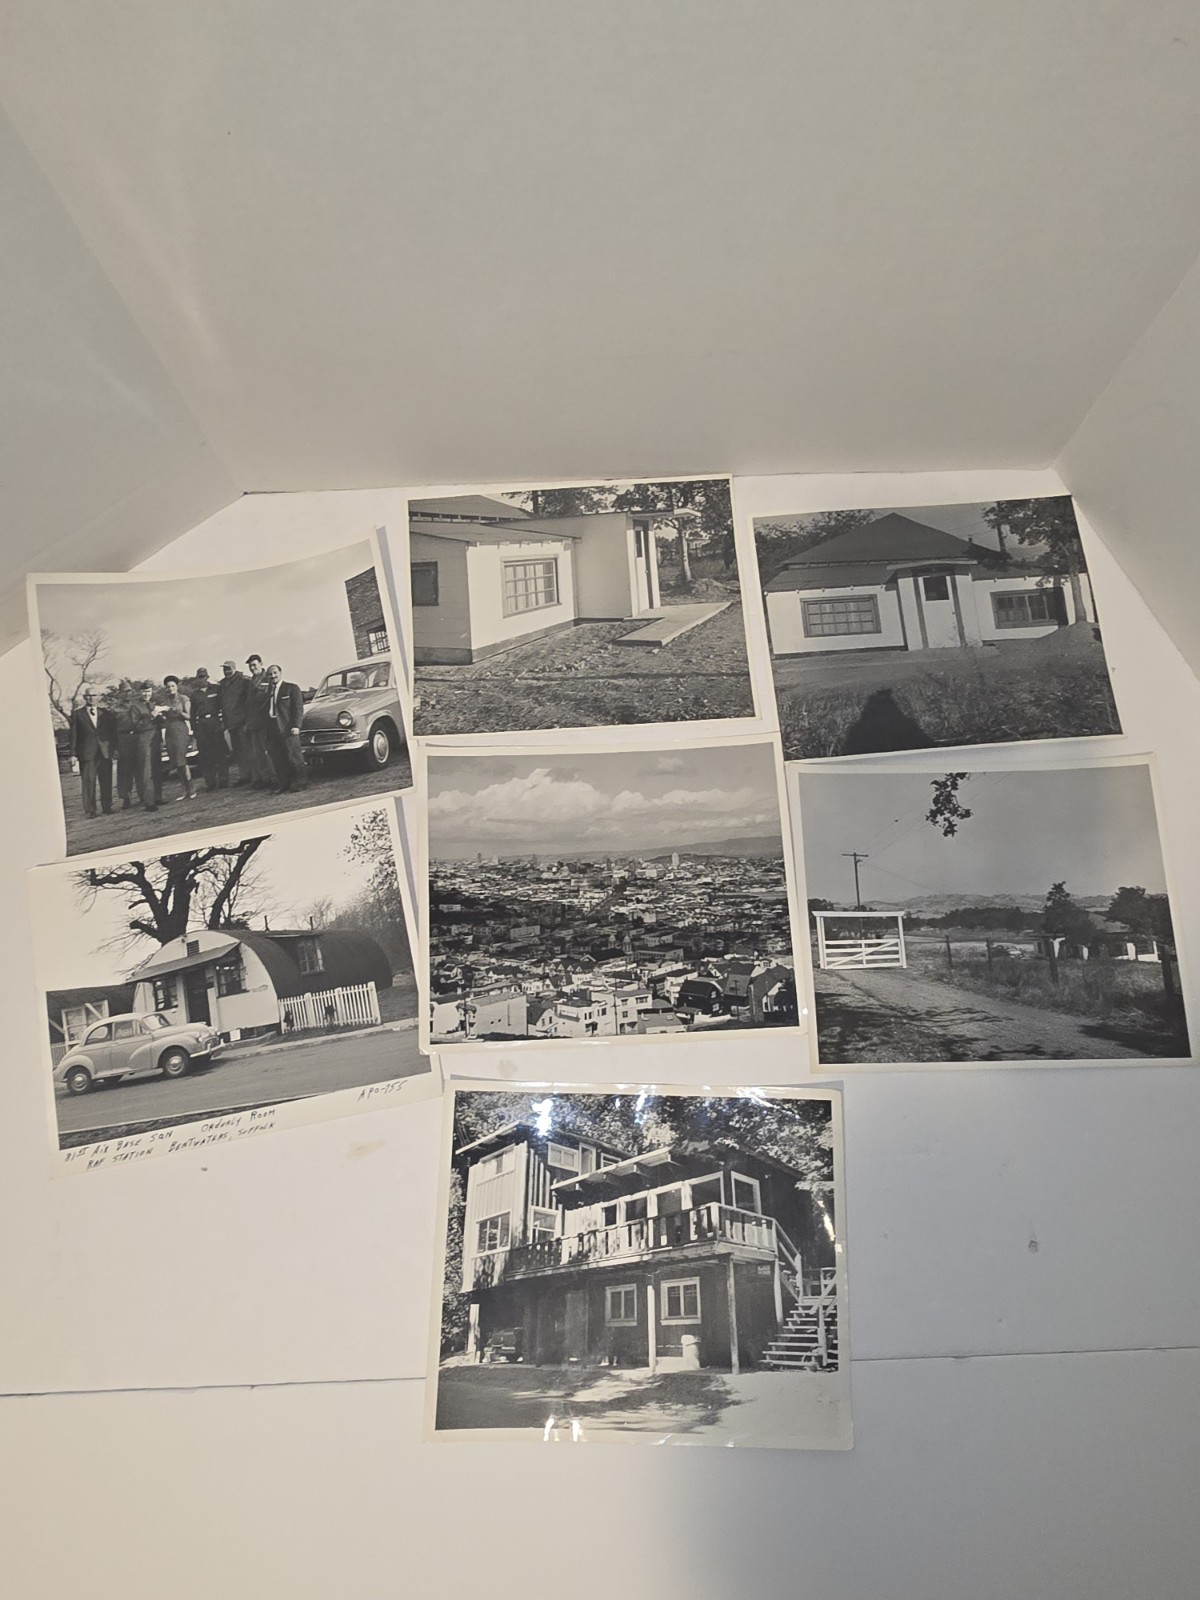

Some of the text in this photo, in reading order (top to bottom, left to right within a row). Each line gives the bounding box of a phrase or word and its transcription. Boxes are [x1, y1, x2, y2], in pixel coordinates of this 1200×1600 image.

[116, 1139, 142, 1152] BASE
[150, 1131, 173, 1142] SQN
[250, 1109, 275, 1121] ROOM
[86, 1157, 106, 1170] RAF
[112, 1147, 154, 1163] STATION
